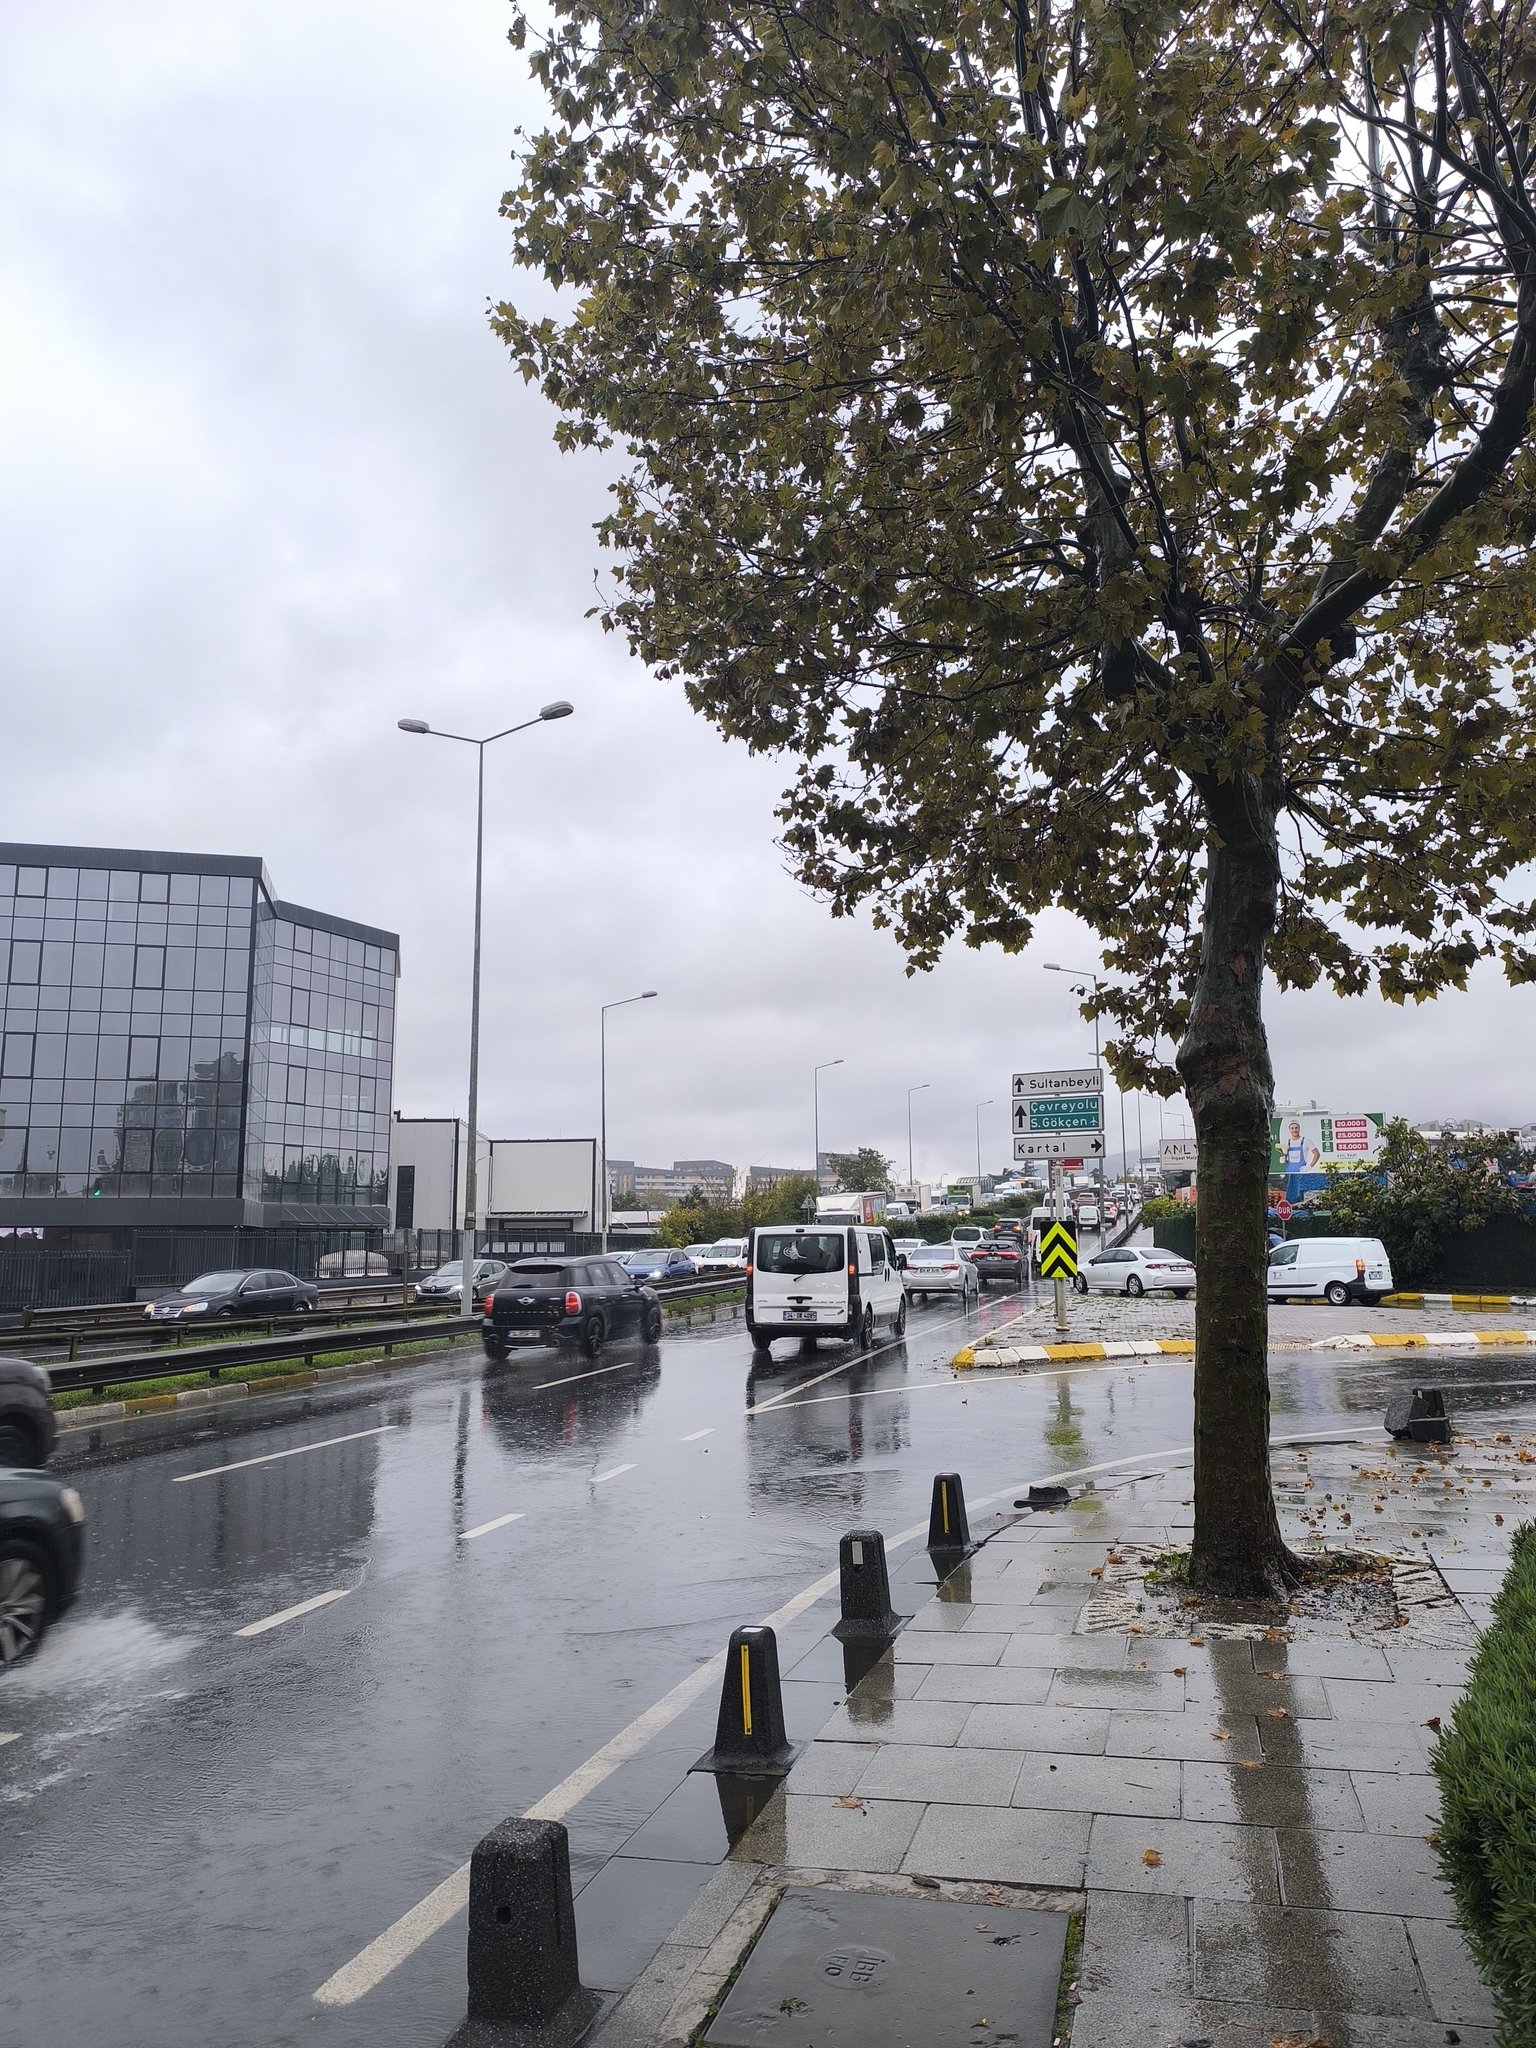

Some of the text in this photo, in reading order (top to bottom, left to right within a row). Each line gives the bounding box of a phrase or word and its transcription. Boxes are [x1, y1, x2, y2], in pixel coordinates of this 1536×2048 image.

[1029, 1076, 1099, 1089] Sultanbeyli
[1030, 1099, 1098, 1113] Çevreyolu
[1018, 1142, 1066, 1154] Kartal
[1278, 1206, 1291, 1214] DUR
